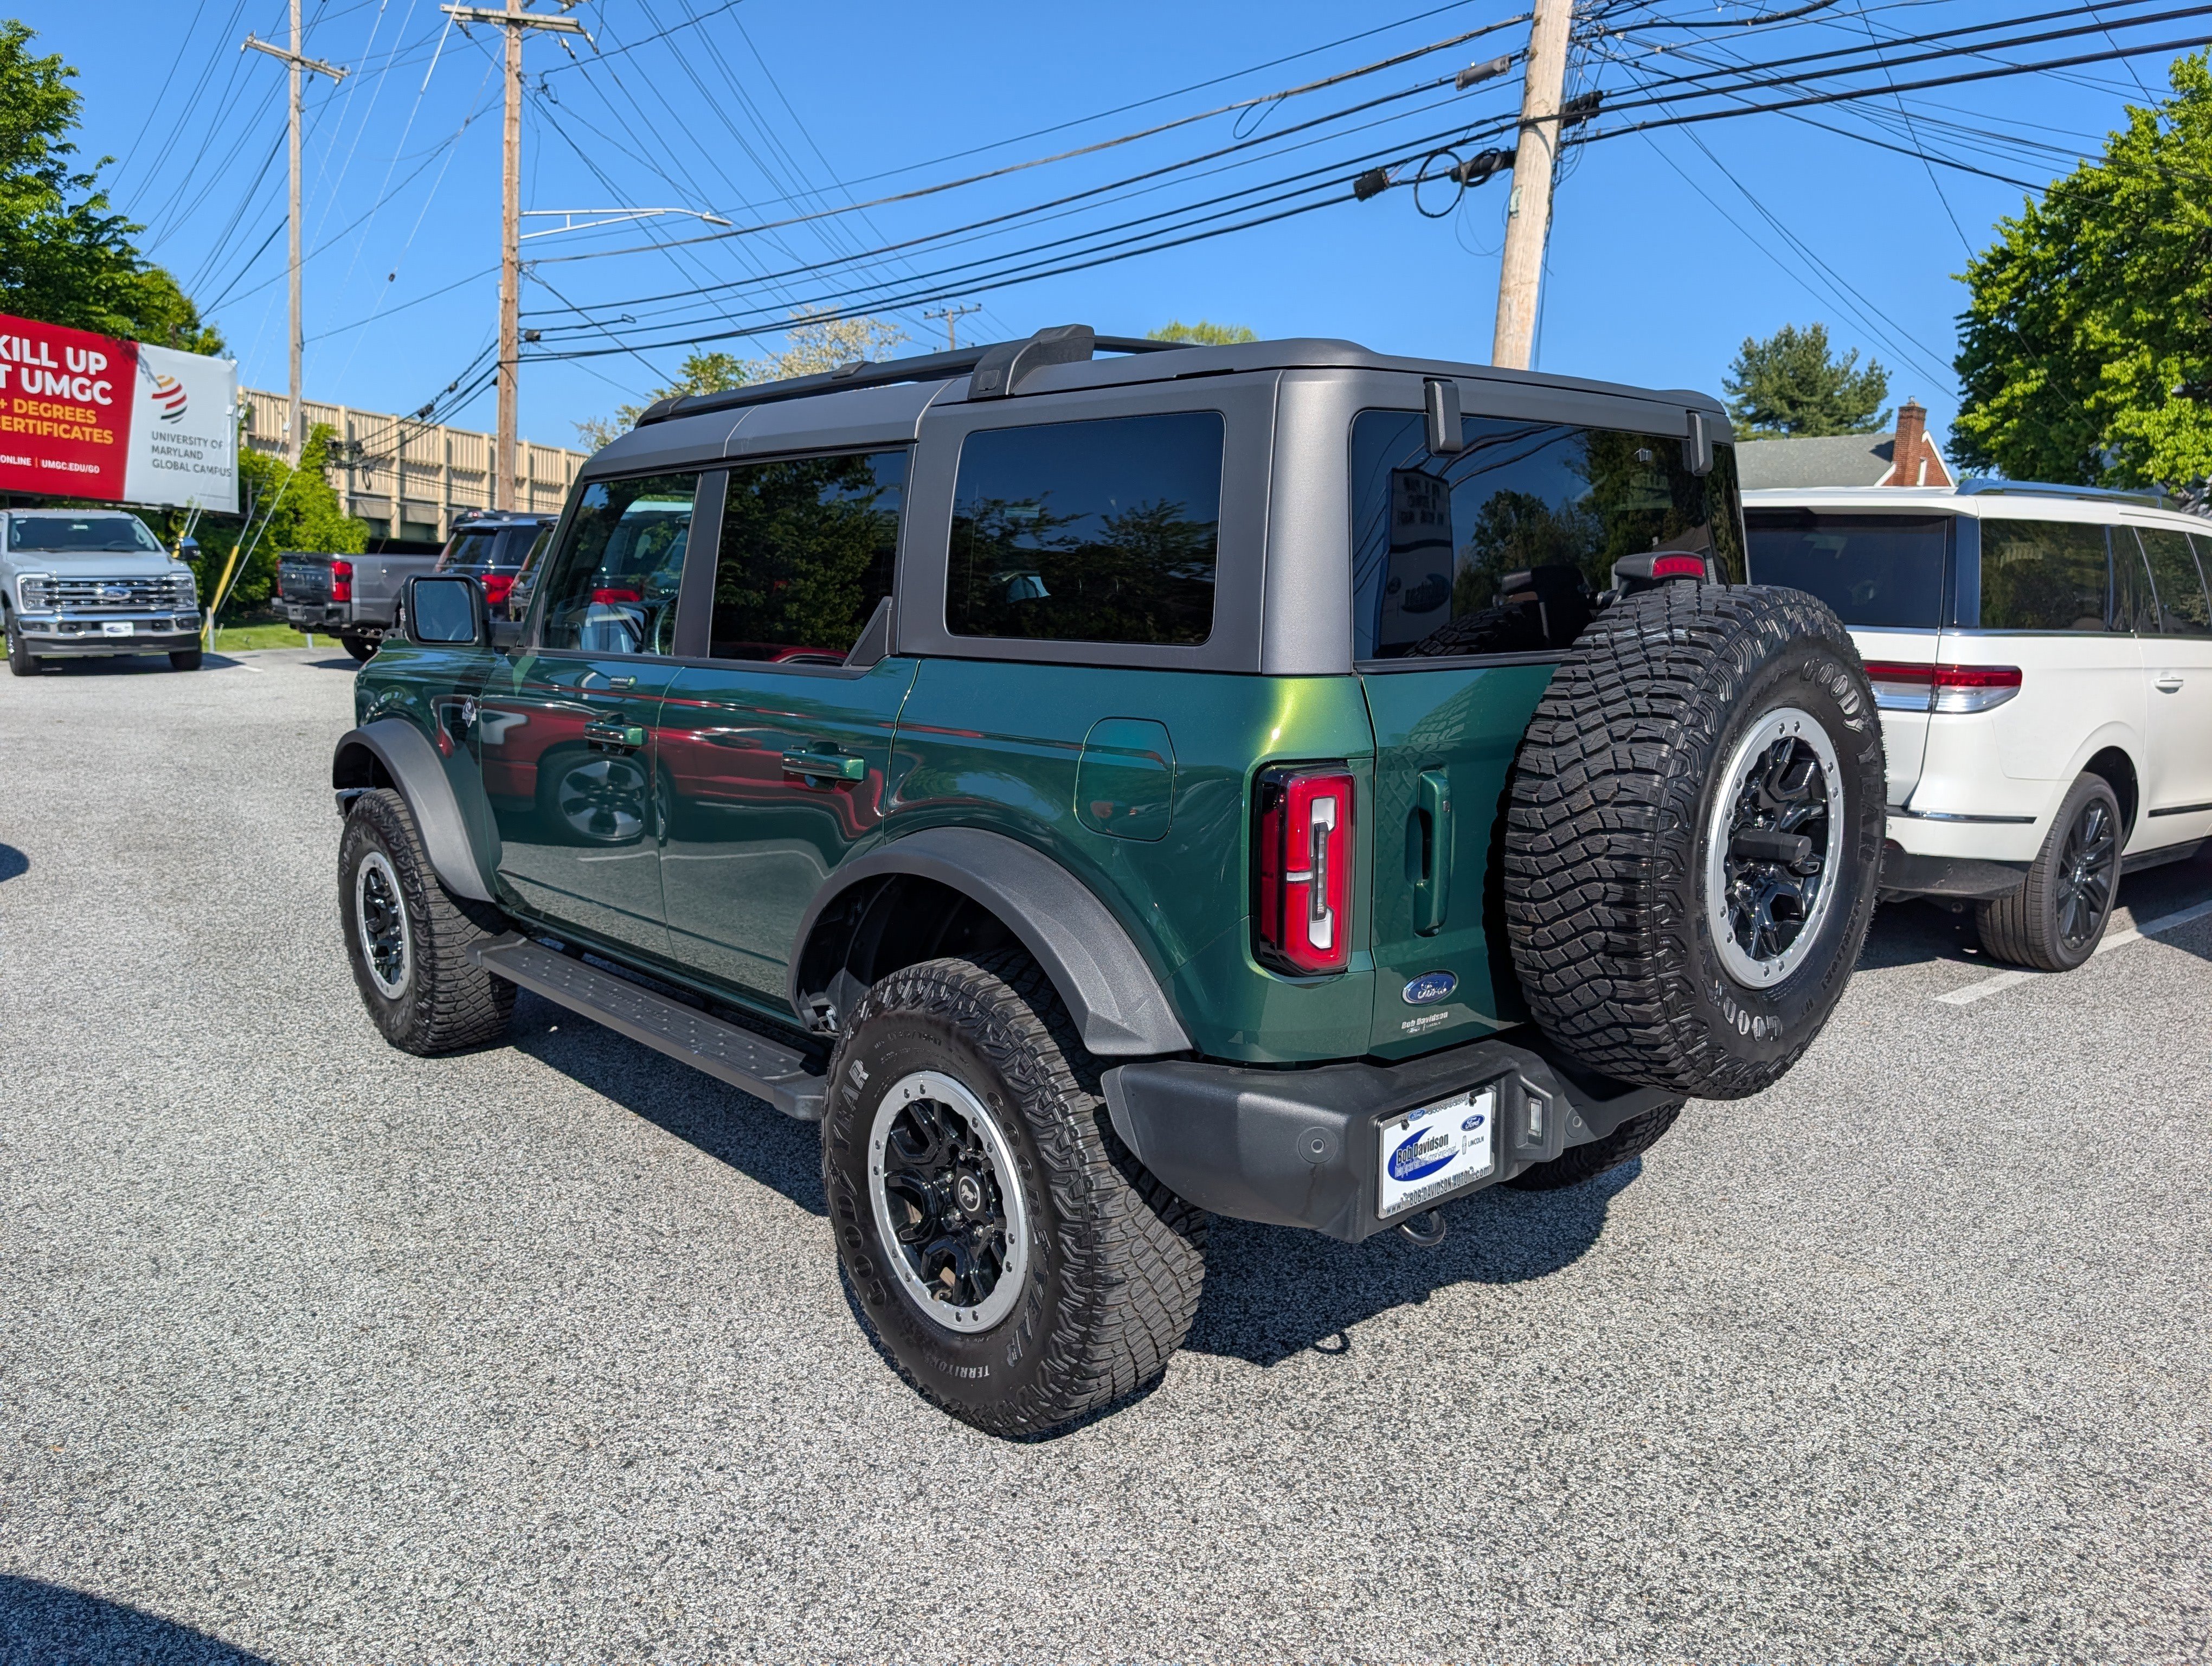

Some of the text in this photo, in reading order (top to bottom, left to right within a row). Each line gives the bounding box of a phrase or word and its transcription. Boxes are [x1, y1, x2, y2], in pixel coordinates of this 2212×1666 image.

[0, 335, 108, 376] KILL UP
[21, 367, 113, 406] UMGC
[14, 398, 97, 425] DEGREES
[0, 415, 114, 445] ERTIFICATES
[152, 431, 224, 450] UNIVERSITY OF
[152, 444, 203, 460] MARYLAND
[0, 454, 100, 474] ONLINE UMGC.EDU/GO
[152, 458, 232, 477] GLOBAL CAMPUS
[1401, 1011, 1448, 1029] Bob Davidson
[1397, 1145, 1412, 1164] Bob
[1413, 1133, 1449, 1156] Davidson
